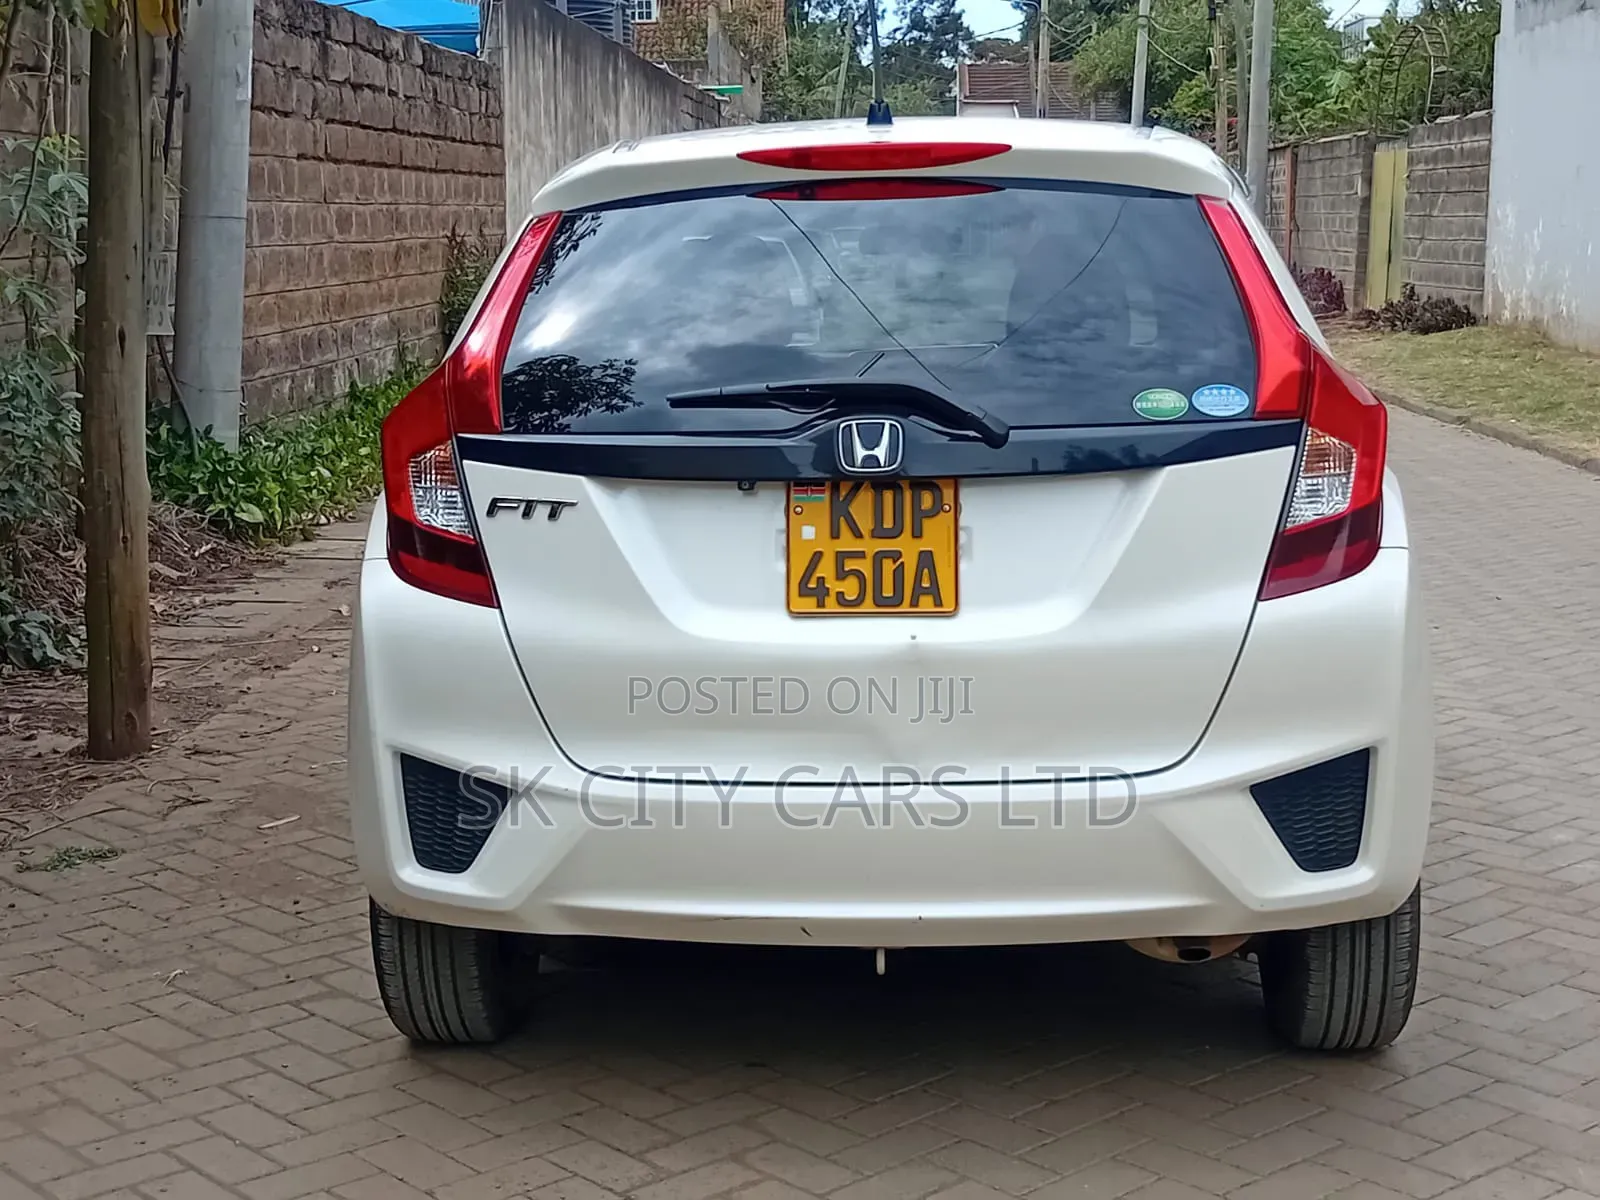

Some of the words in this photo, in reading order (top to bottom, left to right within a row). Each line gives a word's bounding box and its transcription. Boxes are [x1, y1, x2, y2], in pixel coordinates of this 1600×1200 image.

[486, 496, 579, 521] FIT
[830, 481, 944, 540] KDP
[798, 550, 944, 608] 450A
